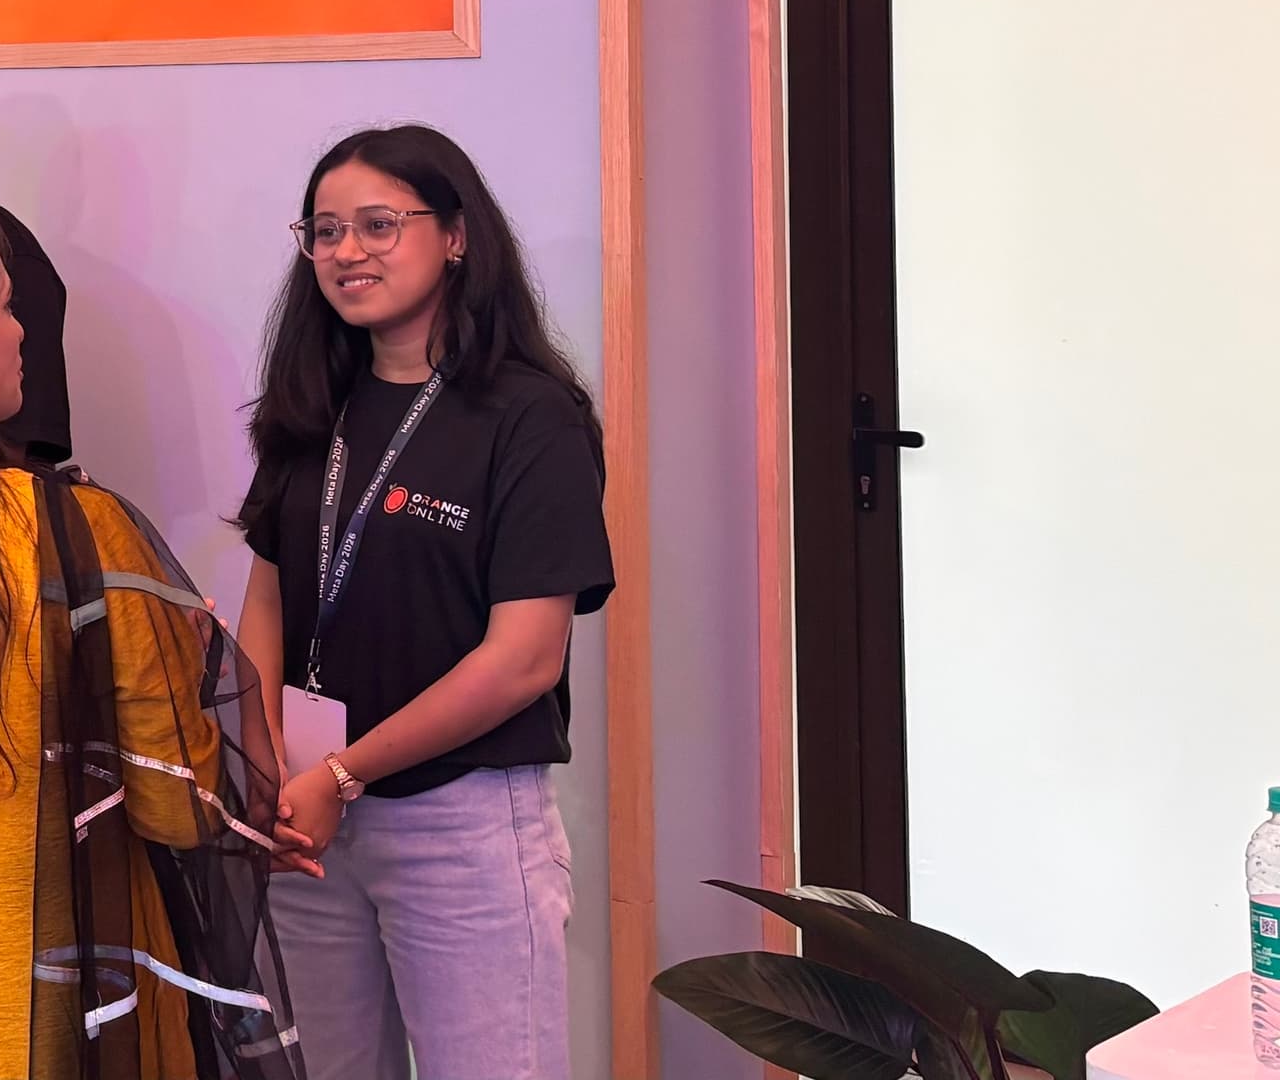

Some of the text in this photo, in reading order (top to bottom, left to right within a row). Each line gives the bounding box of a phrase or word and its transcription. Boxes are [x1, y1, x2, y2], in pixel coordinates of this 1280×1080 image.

[400, 411, 419, 433] Meta
[414, 394, 430, 411] Day
[324, 436, 344, 506] Meta Day 2026
[358, 449, 396, 515] Meta Day 2026
[406, 503, 466, 531] ONLINE
[411, 493, 471, 519] ORANGE
[321, 525, 330, 551] 2026
[327, 532, 357, 603] Meta Day 2026
